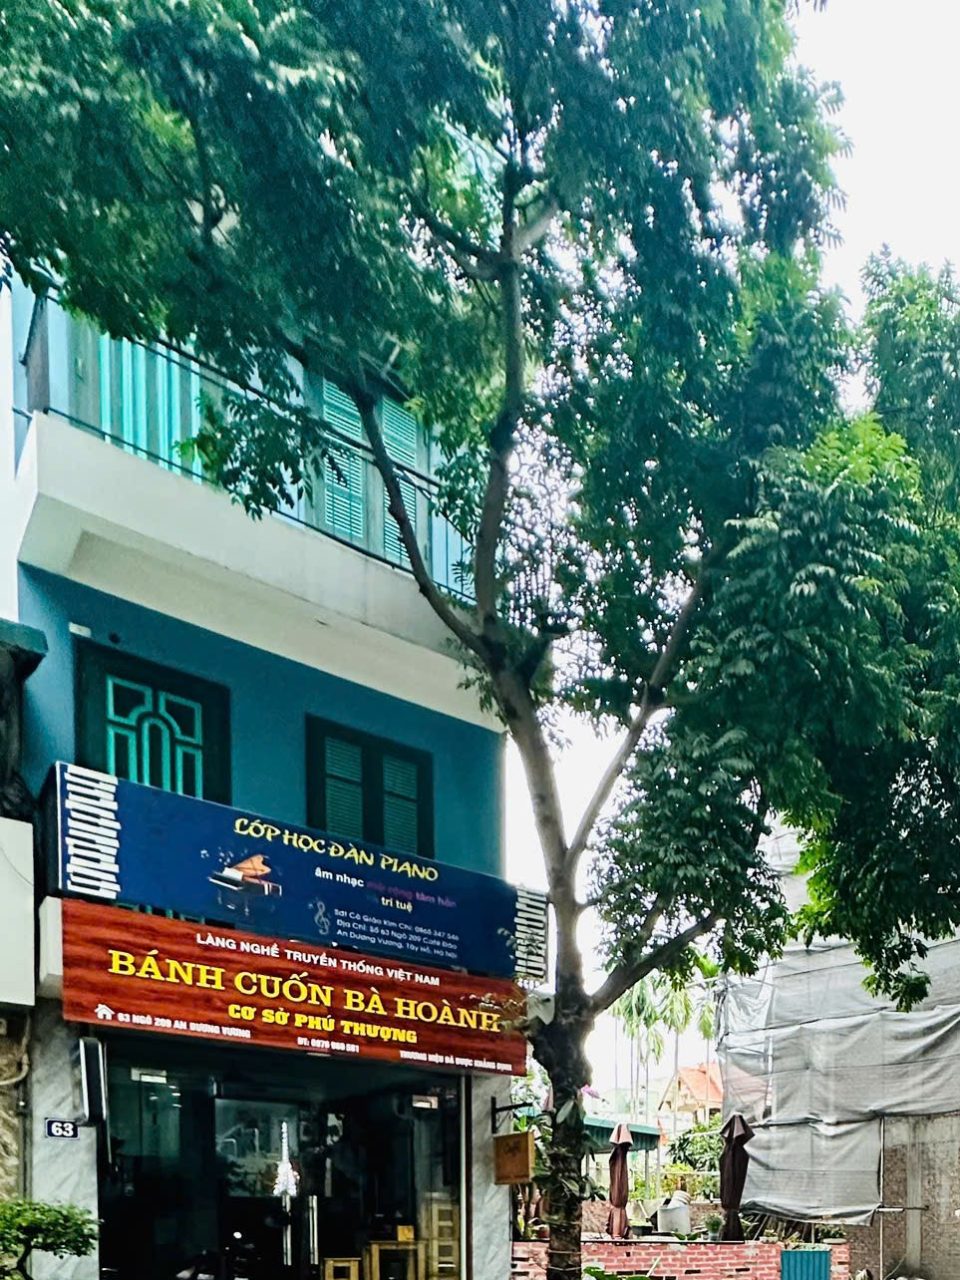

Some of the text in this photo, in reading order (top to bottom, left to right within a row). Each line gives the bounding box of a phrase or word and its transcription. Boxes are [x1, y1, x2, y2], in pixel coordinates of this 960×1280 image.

[283, 829, 326, 854] HỌC
[328, 840, 375, 866] ĐÀN
[379, 853, 439, 881] PIANO
[315, 867, 333, 881] âm
[335, 872, 364, 888] nhạc
[336, 928, 349, 937] An
[196, 932, 237, 950] LÀNG
[340, 959, 384, 977] THỐNG
[386, 968, 413, 982] VIỆT
[414, 973, 440, 986] NAM
[107, 949, 501, 1033] BÁNH CUỐN BÀ HOÀNH
[227, 1004, 418, 1044] CƠ SỞ PHÚ THƯỢNG
[51, 1122, 74, 1137] 63
